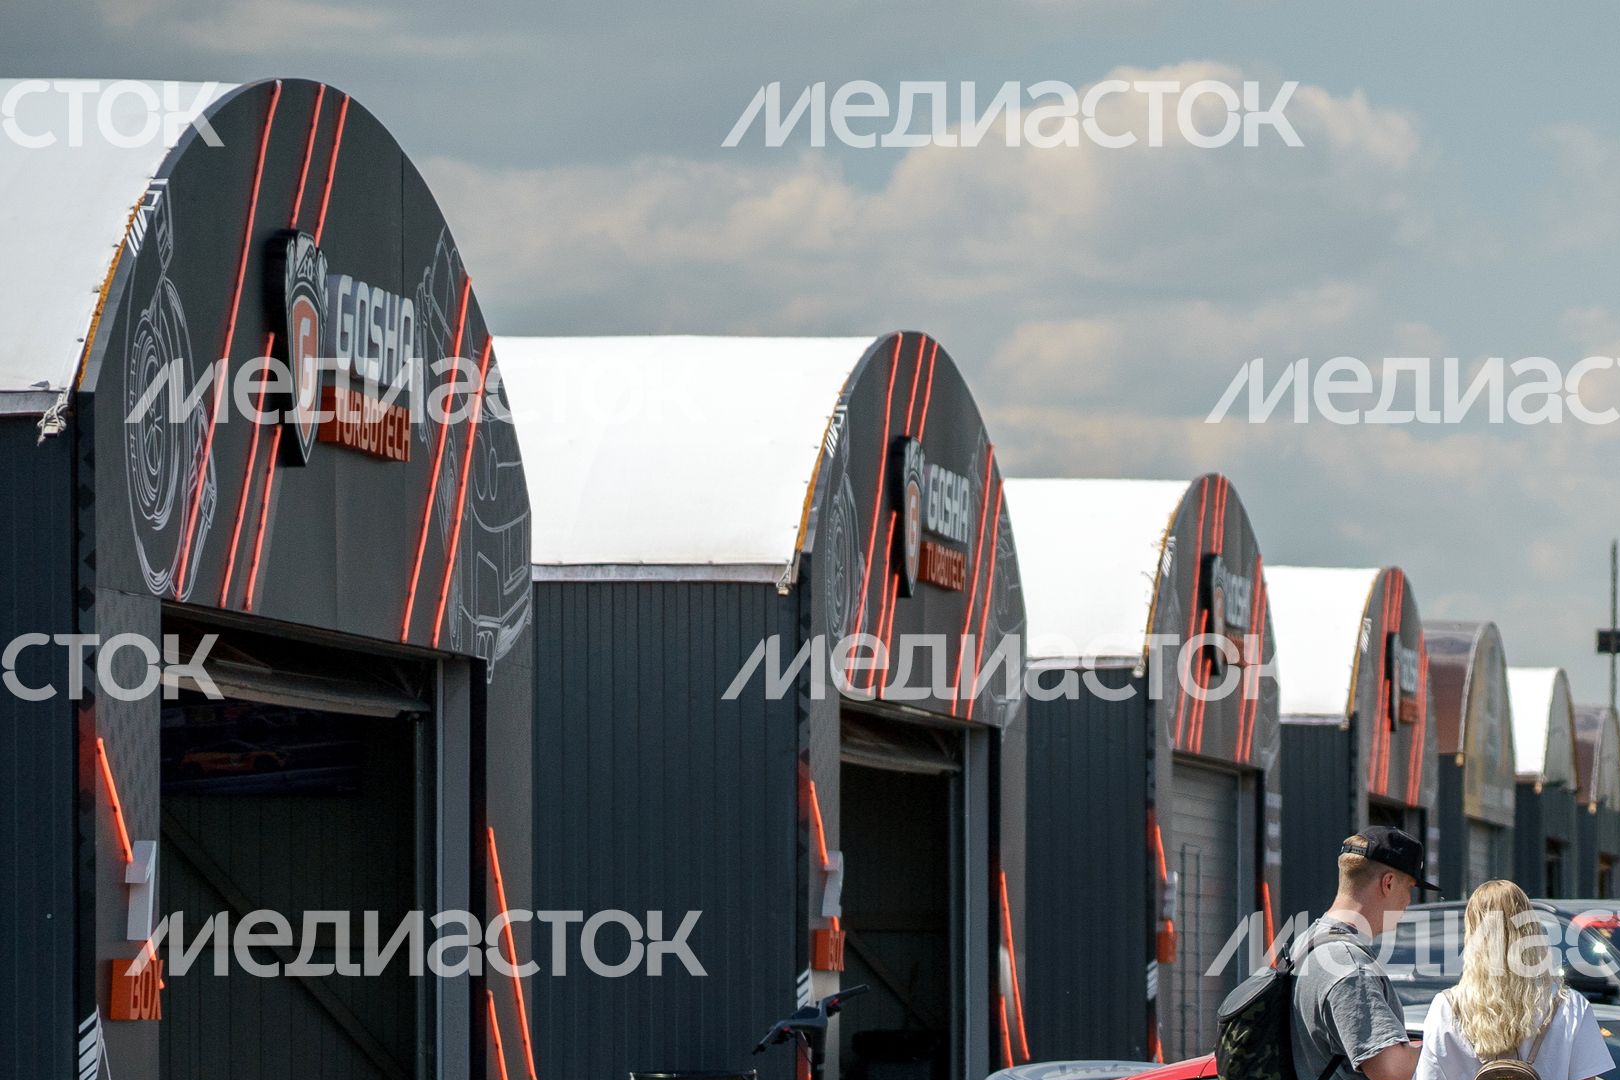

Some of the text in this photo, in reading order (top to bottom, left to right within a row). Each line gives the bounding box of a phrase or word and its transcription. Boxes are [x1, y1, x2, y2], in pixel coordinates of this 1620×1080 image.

[336, 274, 415, 392] GOSHA
[335, 387, 411, 462] TURBOTECH
[926, 463, 970, 543] GOSHA
[926, 543, 967, 592] TURBOTECH
[130, 959, 164, 1020] BOX
